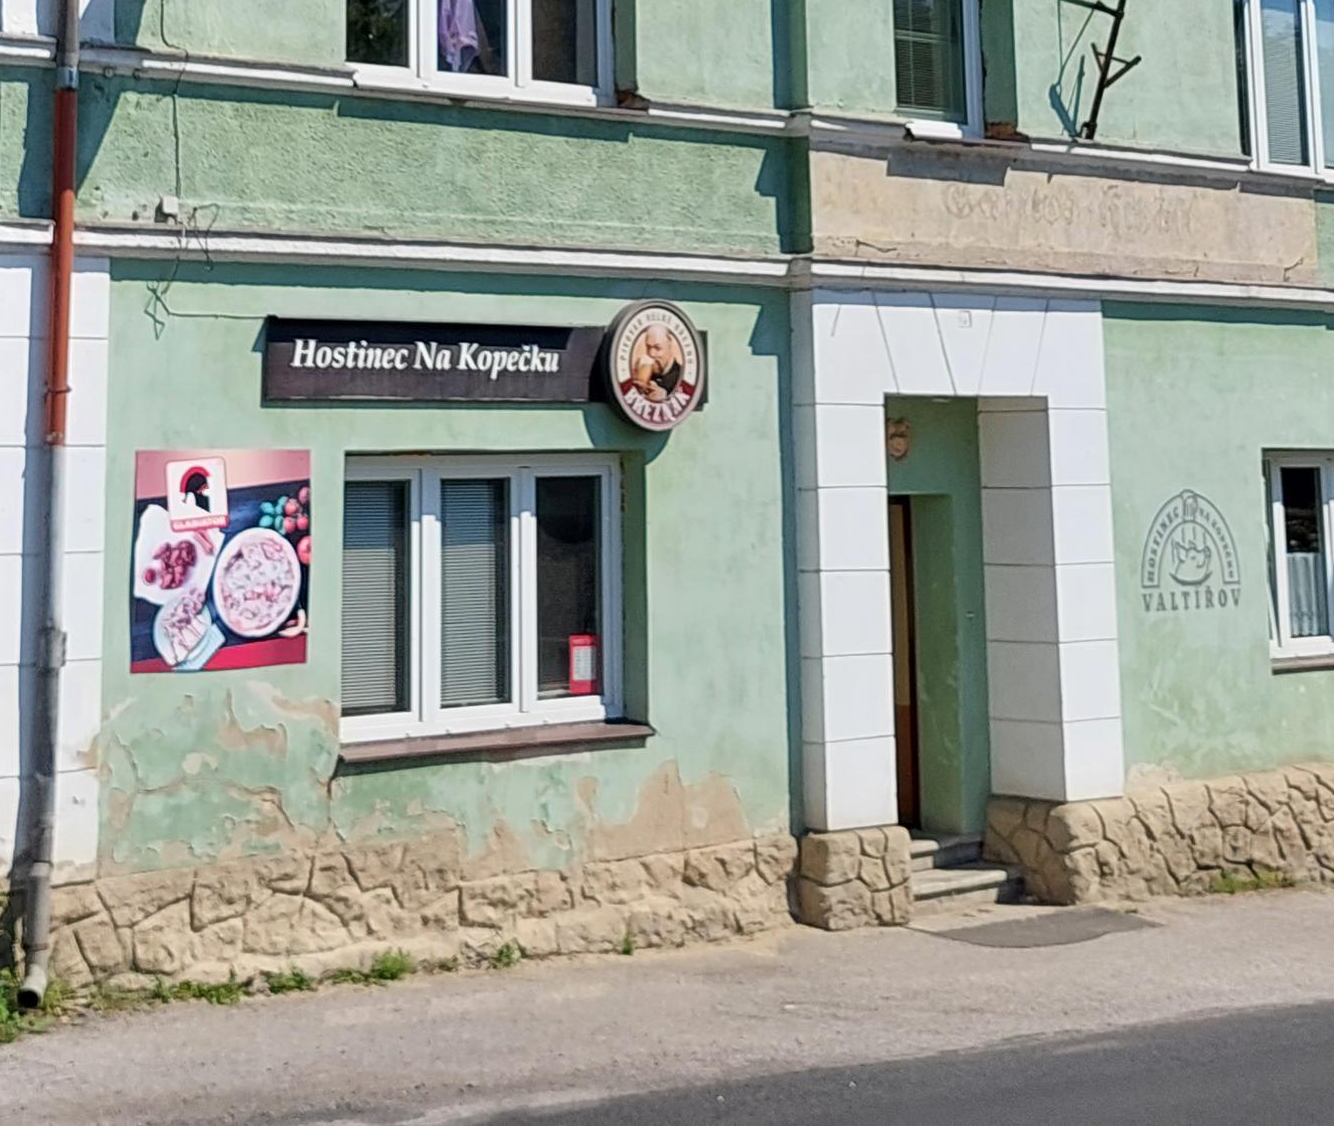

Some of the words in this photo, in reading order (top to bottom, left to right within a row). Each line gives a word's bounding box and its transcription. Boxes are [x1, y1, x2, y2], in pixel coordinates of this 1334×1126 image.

[290, 339, 408, 369] Hostinec
[413, 341, 452, 370] Na
[456, 342, 559, 380] Kopečku
[173, 516, 227, 530] GLADIATOR
[1147, 505, 1179, 582] HOSTINEC
[1141, 585, 1241, 612] VALTÍŘOV
